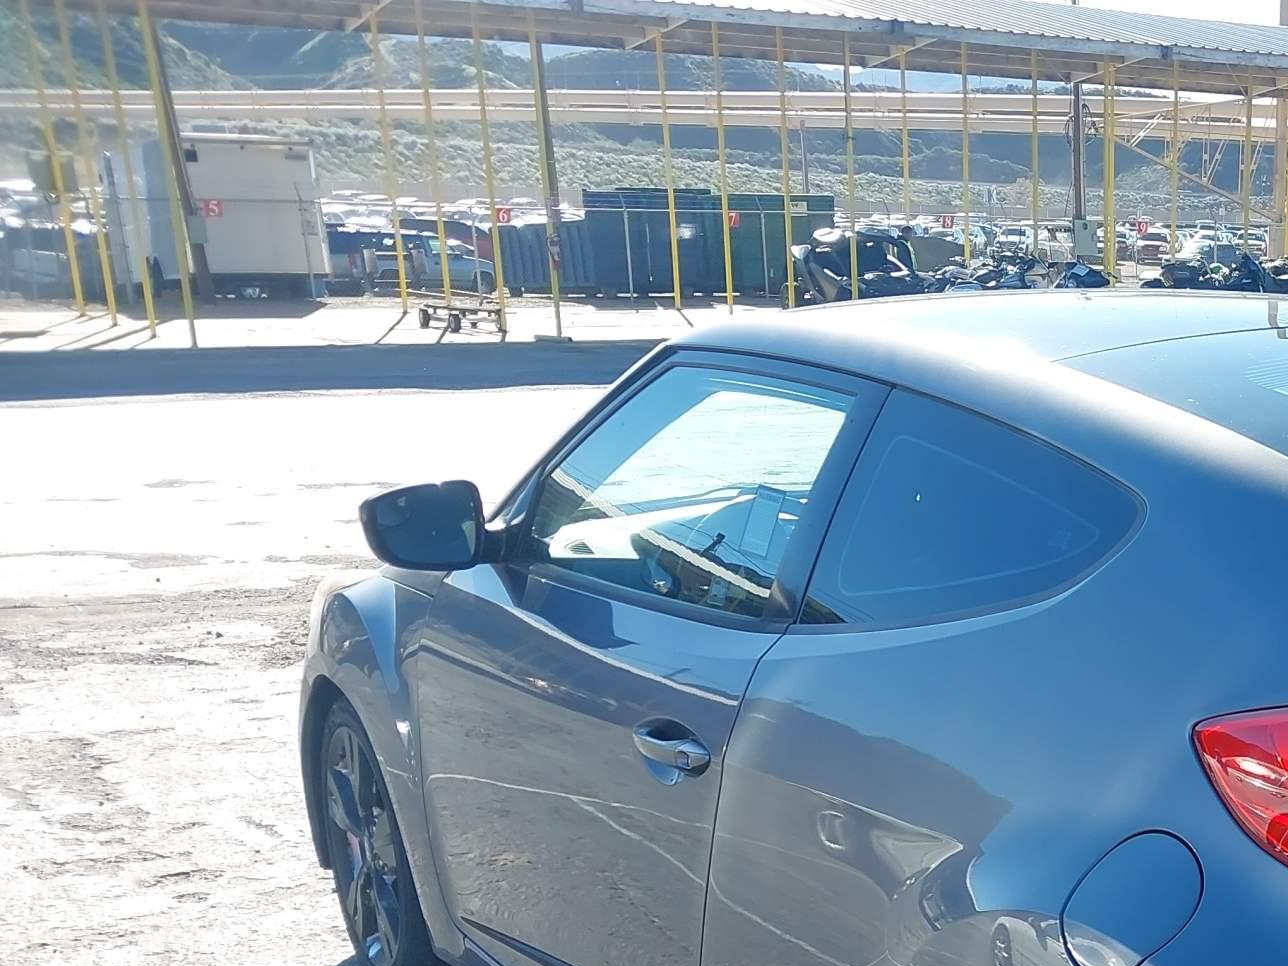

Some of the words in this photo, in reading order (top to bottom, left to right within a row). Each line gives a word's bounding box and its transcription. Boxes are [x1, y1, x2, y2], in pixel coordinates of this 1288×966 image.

[208, 200, 218, 216] 5
[498, 208, 508, 222] 6
[728, 212, 736, 226] 7
[944, 215, 952, 228] 8
[1139, 222, 1147, 233] 9
